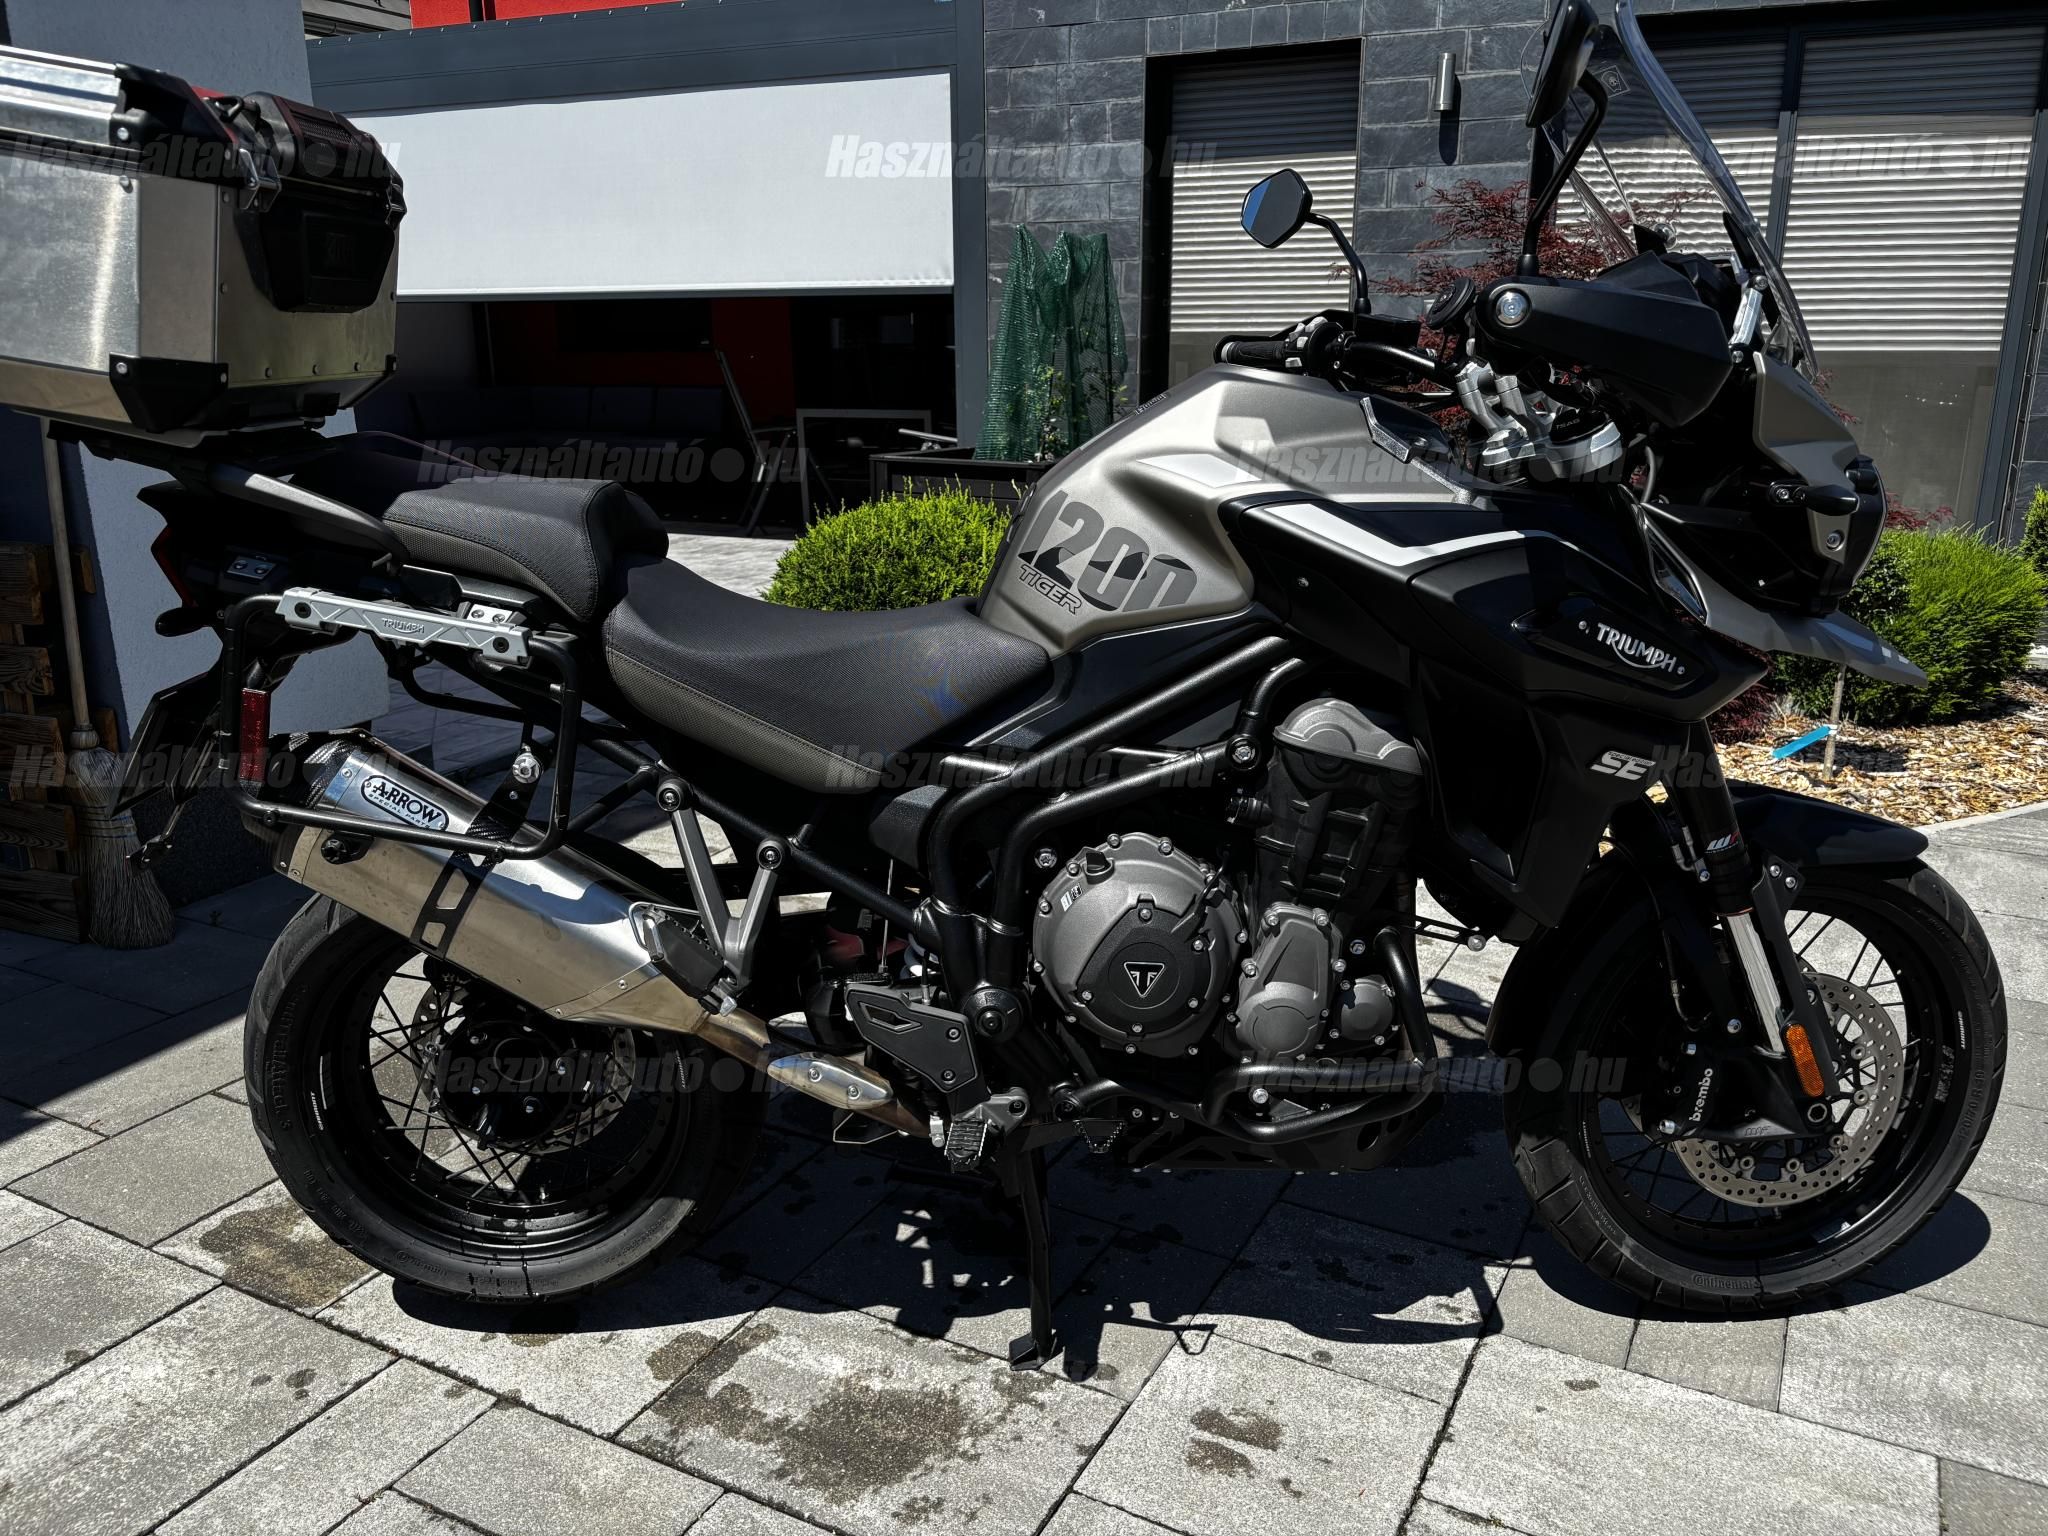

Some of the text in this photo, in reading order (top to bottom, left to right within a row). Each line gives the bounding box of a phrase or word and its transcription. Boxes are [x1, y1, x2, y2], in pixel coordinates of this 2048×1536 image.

[1017, 490, 1197, 612] 1200
[1018, 564, 1083, 615] TIGER
[381, 618, 425, 634] TRIUMPH
[1596, 622, 1677, 673] TRIUMPH
[1590, 751, 1656, 781] SE
[372, 781, 442, 823] ARROW
[1688, 1067, 1714, 1122] brembo
[1690, 1273, 1753, 1290] Continental
